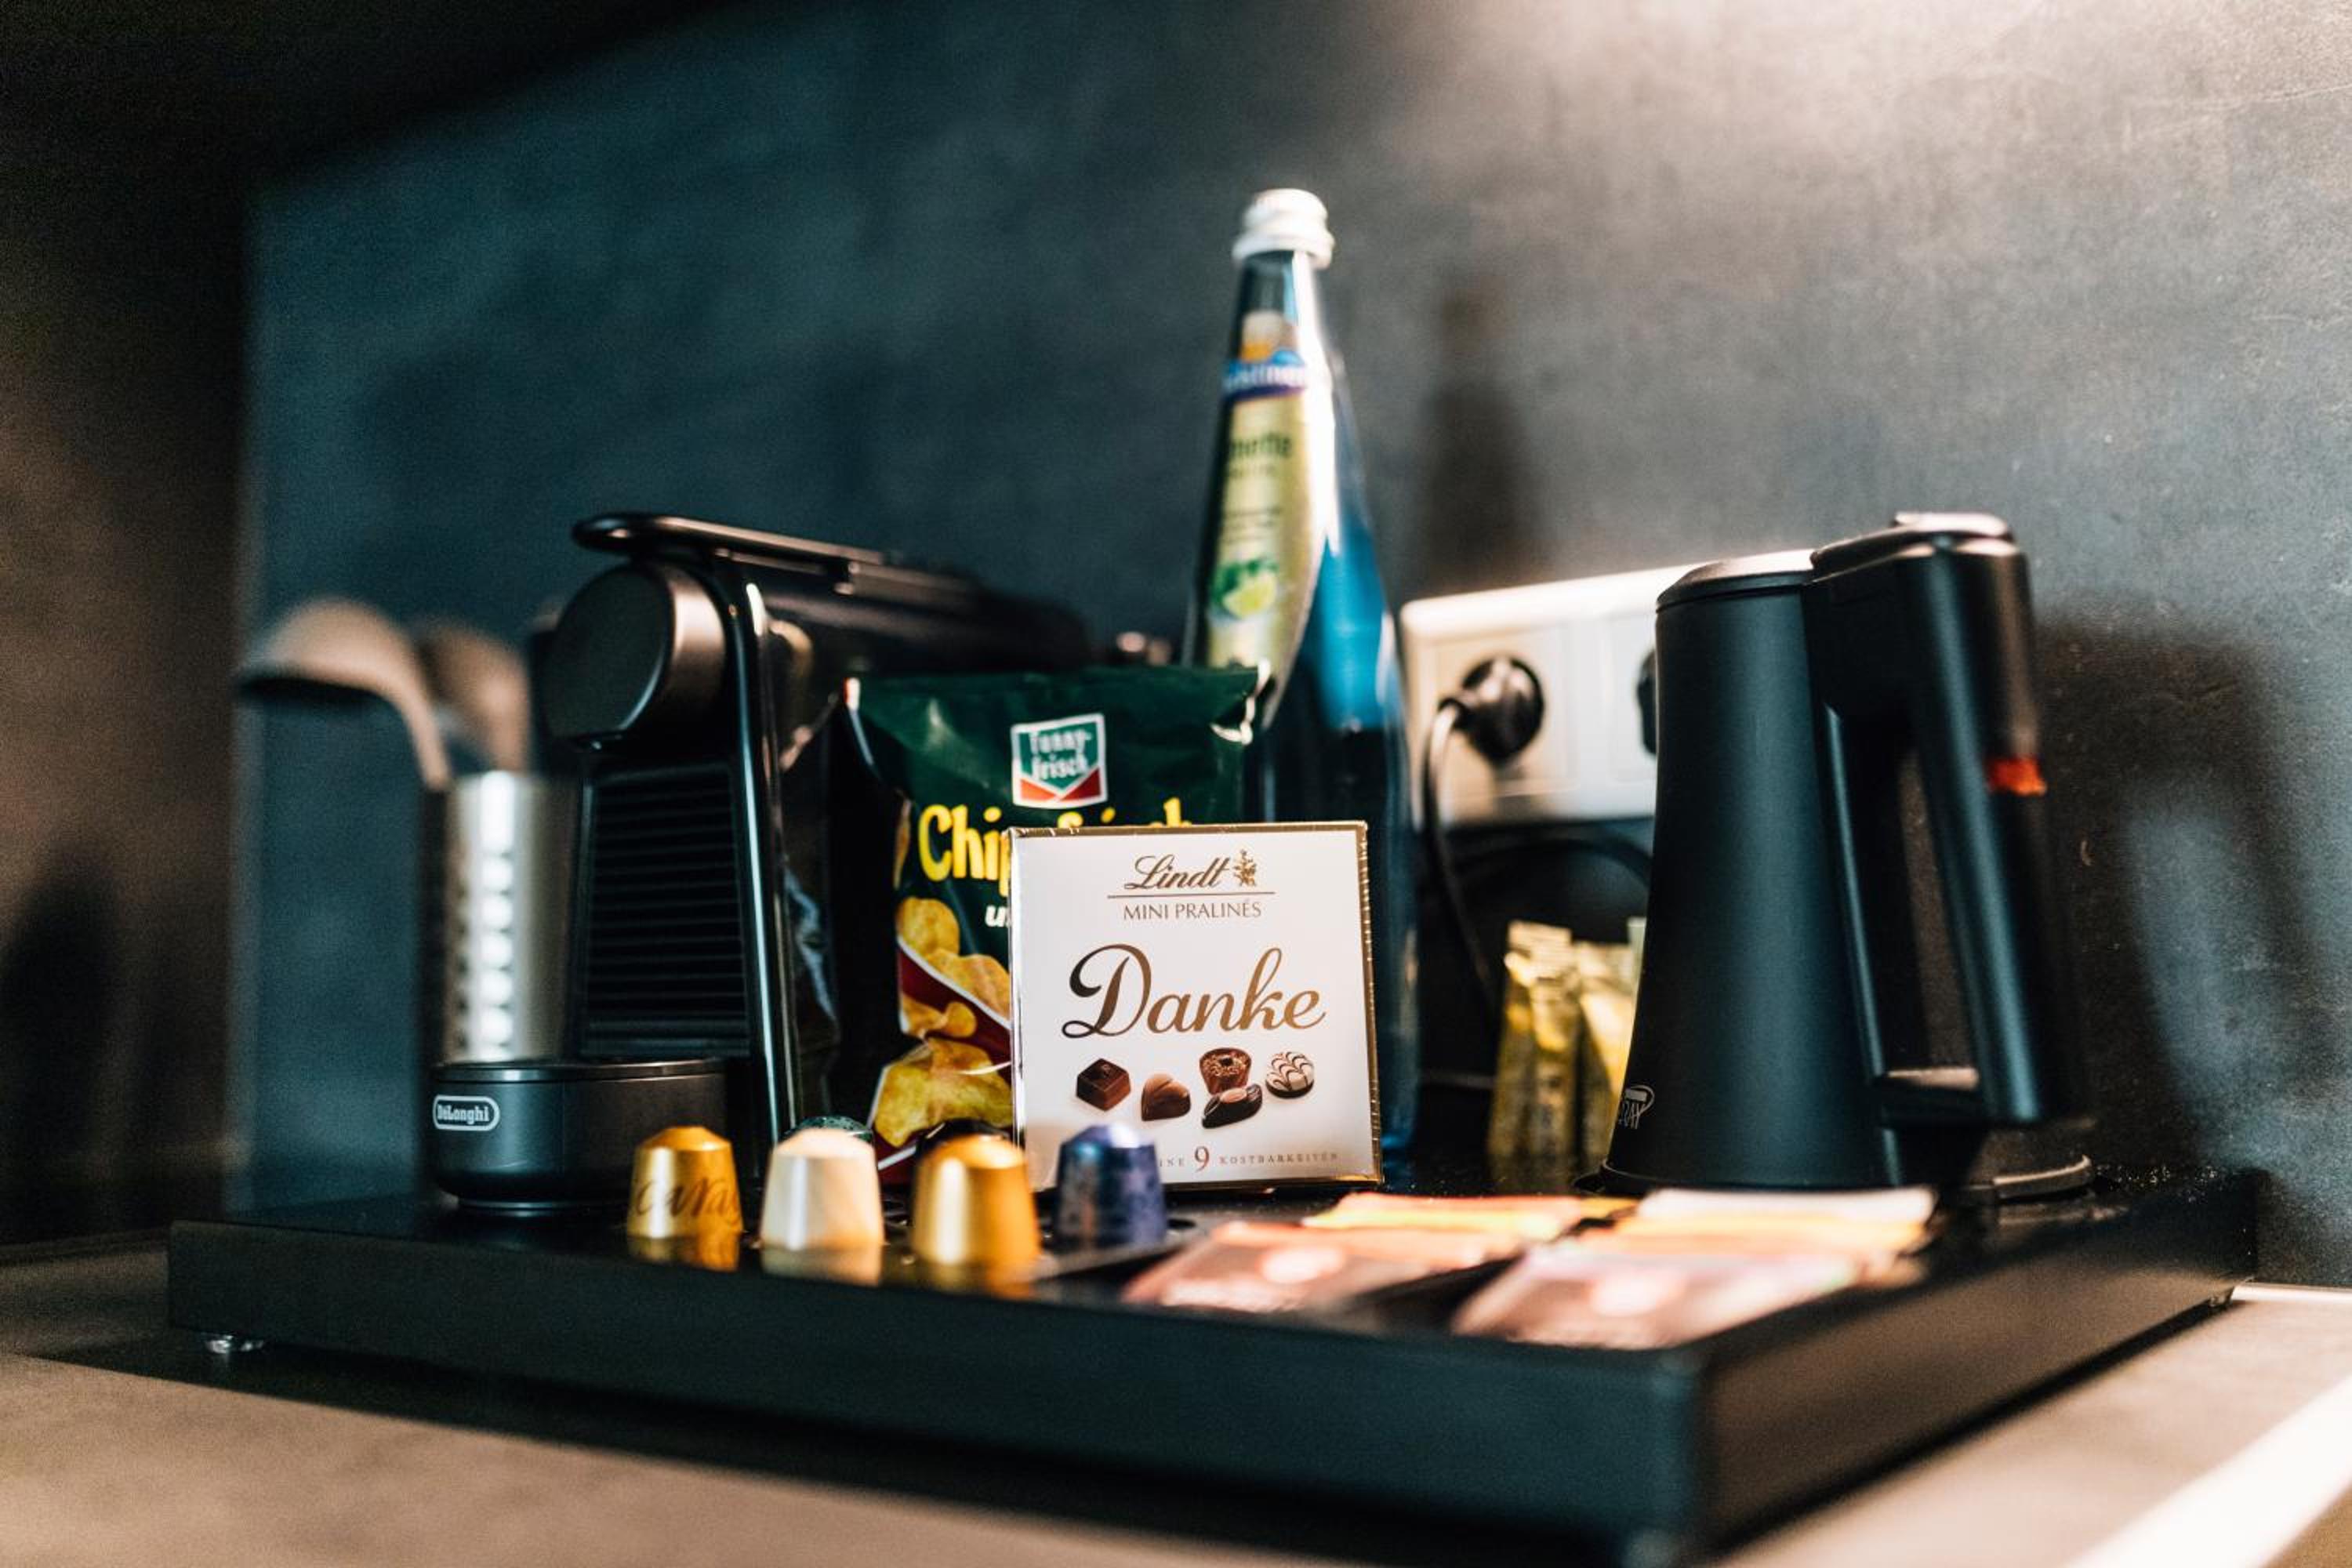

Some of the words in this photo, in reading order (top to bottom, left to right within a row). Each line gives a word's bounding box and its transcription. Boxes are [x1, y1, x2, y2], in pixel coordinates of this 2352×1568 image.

[1123, 853, 1231, 891] Lindt
[1123, 902, 1169, 921] MINI
[1175, 898, 1262, 920] PRALINÉS
[1061, 943, 1327, 1039] Danke
[1194, 1145, 1210, 1173] 9
